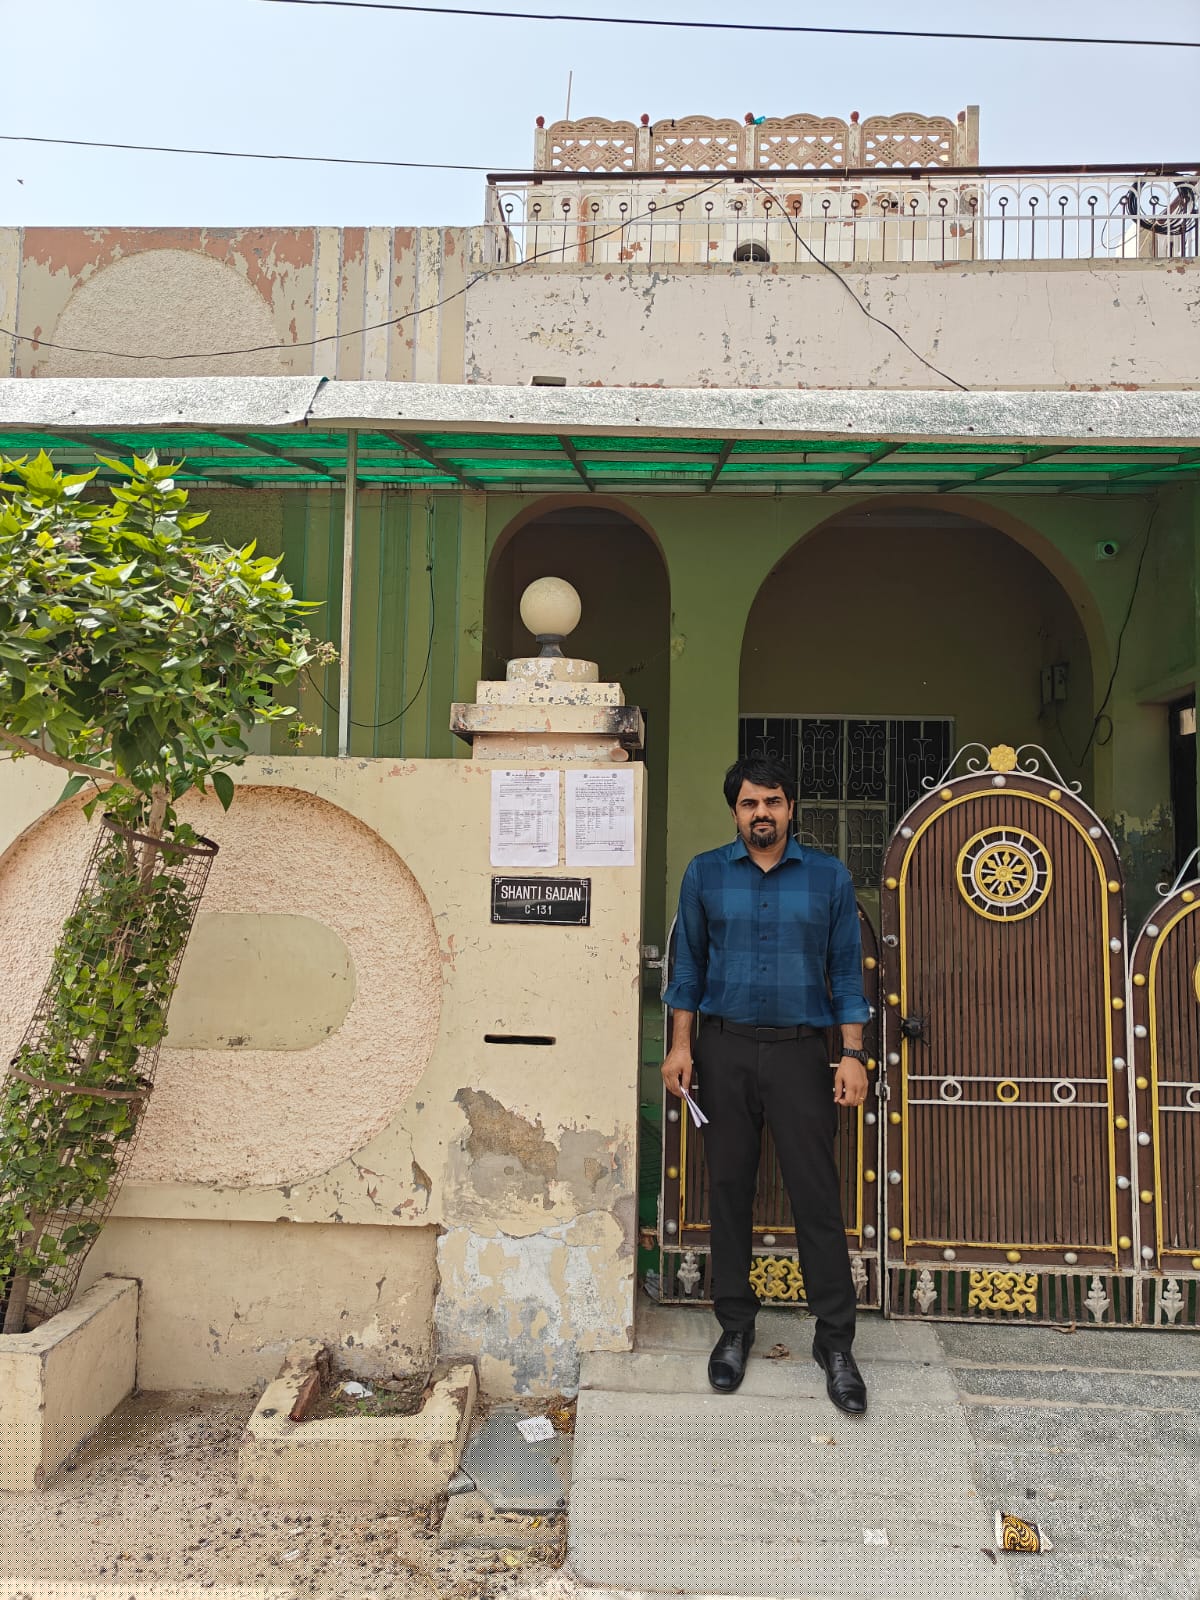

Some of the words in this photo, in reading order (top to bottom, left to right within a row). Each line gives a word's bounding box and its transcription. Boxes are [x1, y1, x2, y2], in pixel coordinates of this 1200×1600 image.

[501, 885, 542, 899] SHANTI
[545, 887, 581, 901] SADAN
[524, 904, 552, 916] C-131
